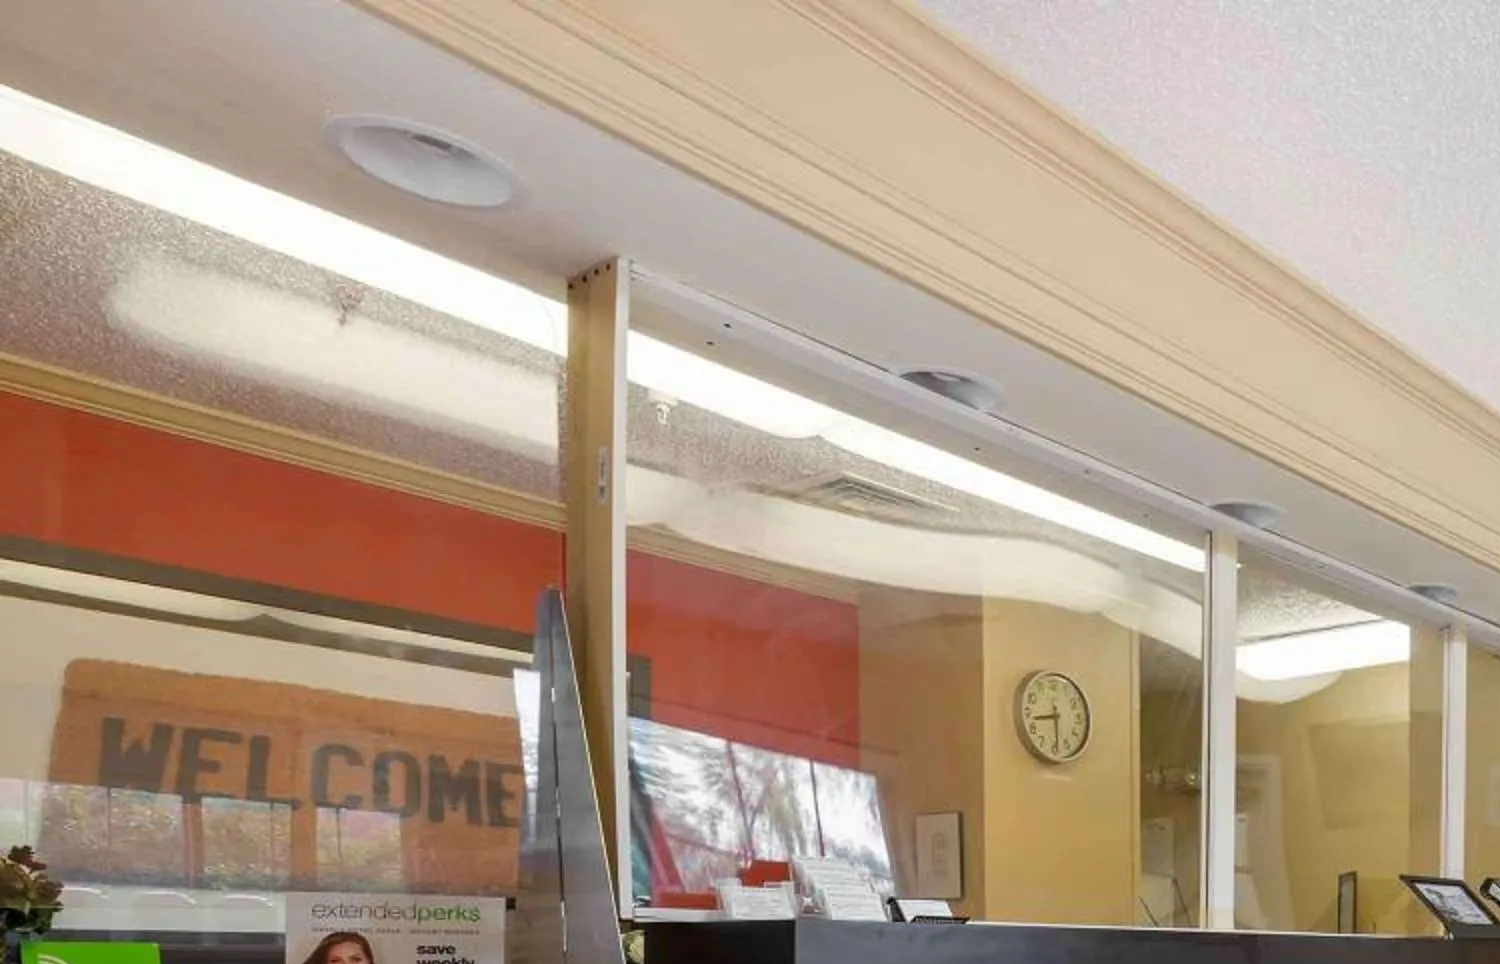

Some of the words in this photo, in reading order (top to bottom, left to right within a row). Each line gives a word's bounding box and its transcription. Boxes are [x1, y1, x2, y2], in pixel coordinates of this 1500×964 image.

[98, 716, 526, 828] WELCOME
[311, 901, 481, 924] extendedperks
[416, 944, 456, 955] save
